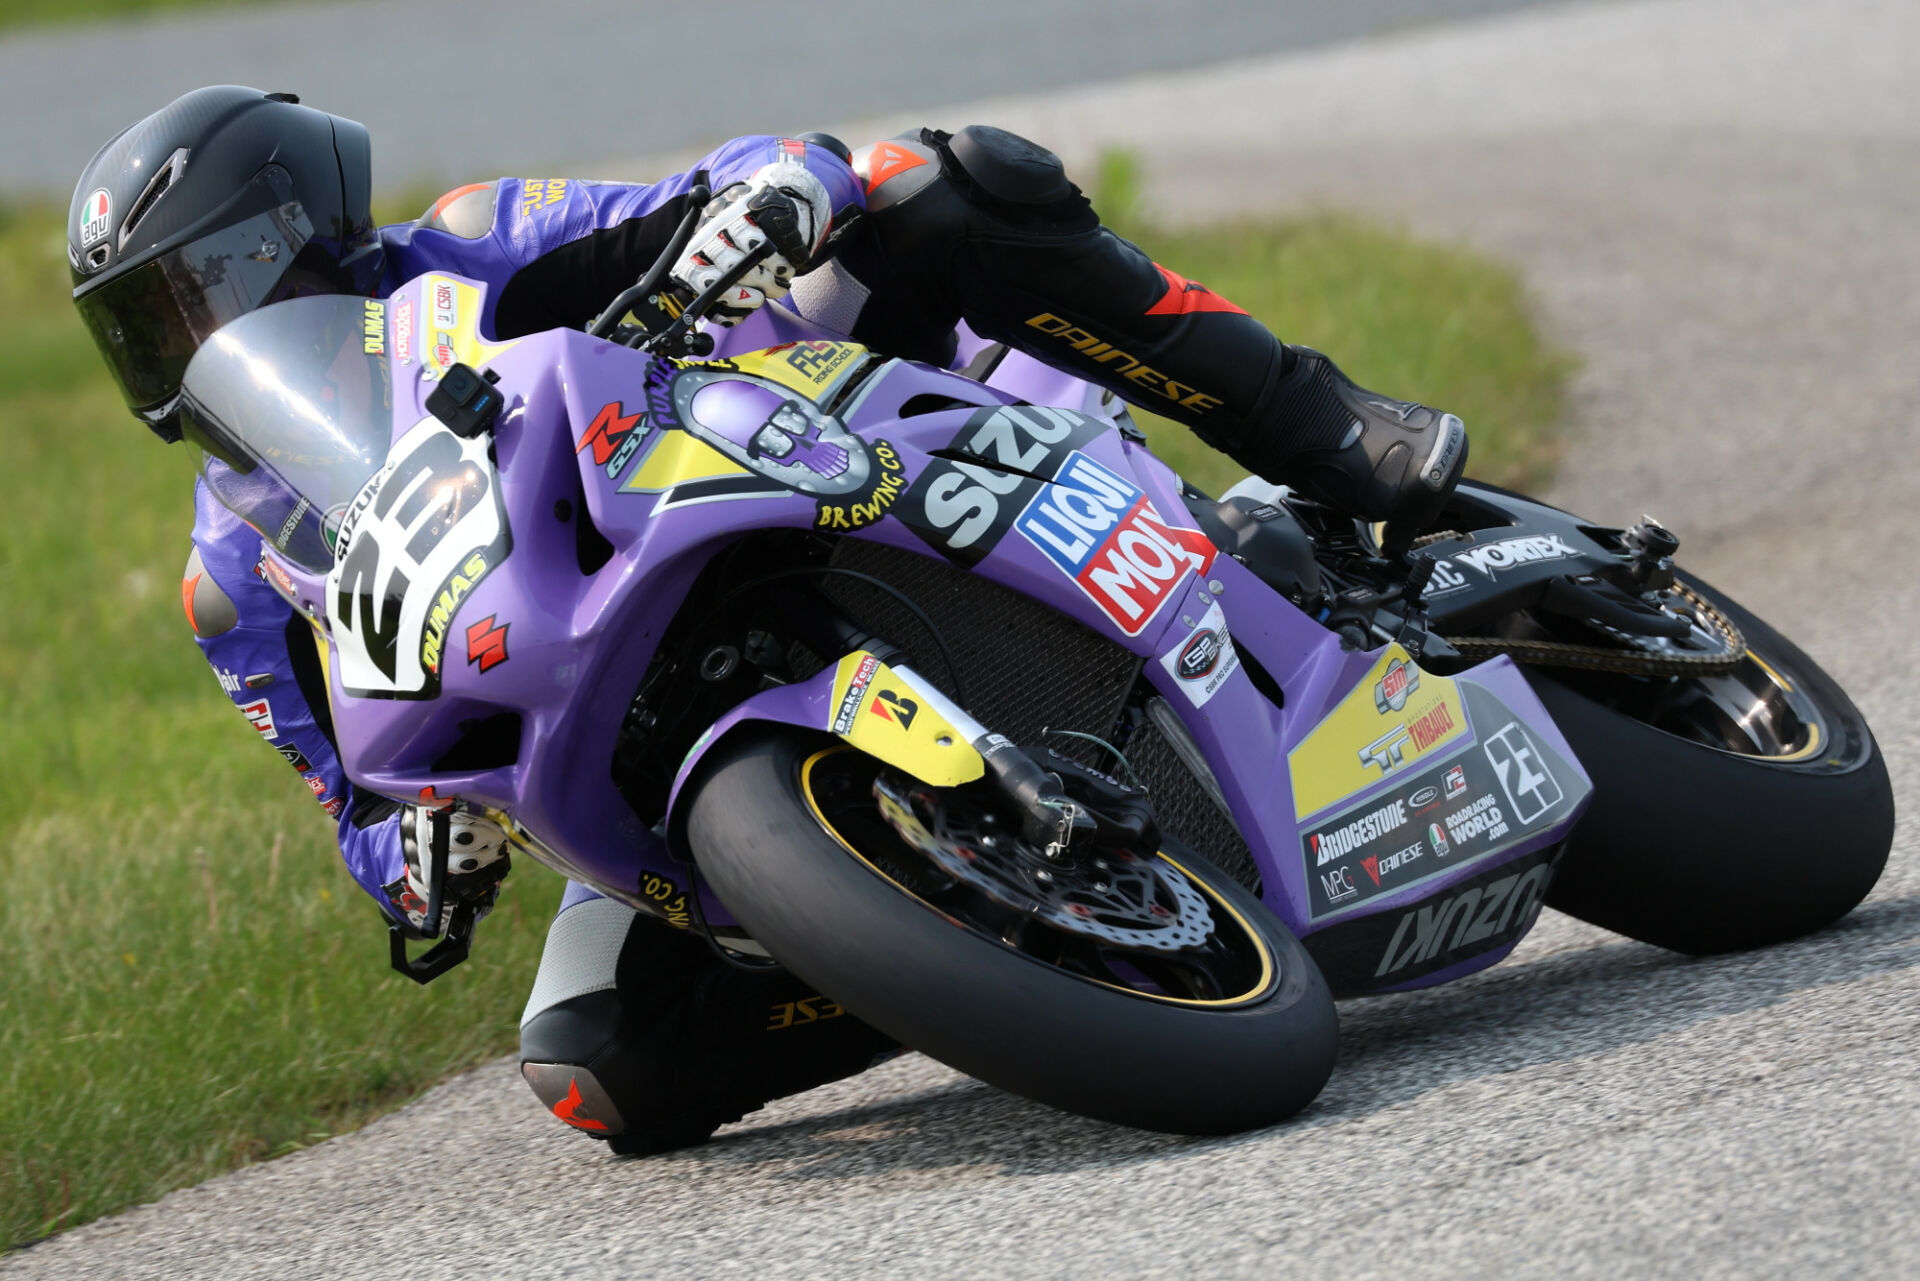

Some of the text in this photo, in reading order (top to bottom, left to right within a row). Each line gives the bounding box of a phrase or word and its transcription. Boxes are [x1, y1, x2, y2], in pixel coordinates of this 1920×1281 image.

[83, 220, 108, 245] agv
[364, 300, 385, 354] DUMAS
[1024, 312, 1224, 414] DAINESE
[650, 358, 678, 425] PURPLE
[607, 415, 654, 480] GSX
[817, 473, 905, 529] BREWING
[924, 404, 1086, 549] SUZU
[1025, 457, 1136, 566] LIQUI
[1088, 500, 1206, 622] MOLY
[1455, 535, 1579, 575] VORTEX
[422, 552, 489, 676] DUMAS
[834, 656, 875, 733] BrakeTech
[1408, 702, 1455, 753] THIBAULT
[1316, 798, 1408, 867] BRIDGESTONE
[1445, 793, 1496, 829] ROADRACING
[1450, 809, 1504, 845] WORLD
[1487, 821, 1510, 842] .com
[1320, 865, 1354, 899] MPC
[1378, 841, 1424, 876] DAINESE
